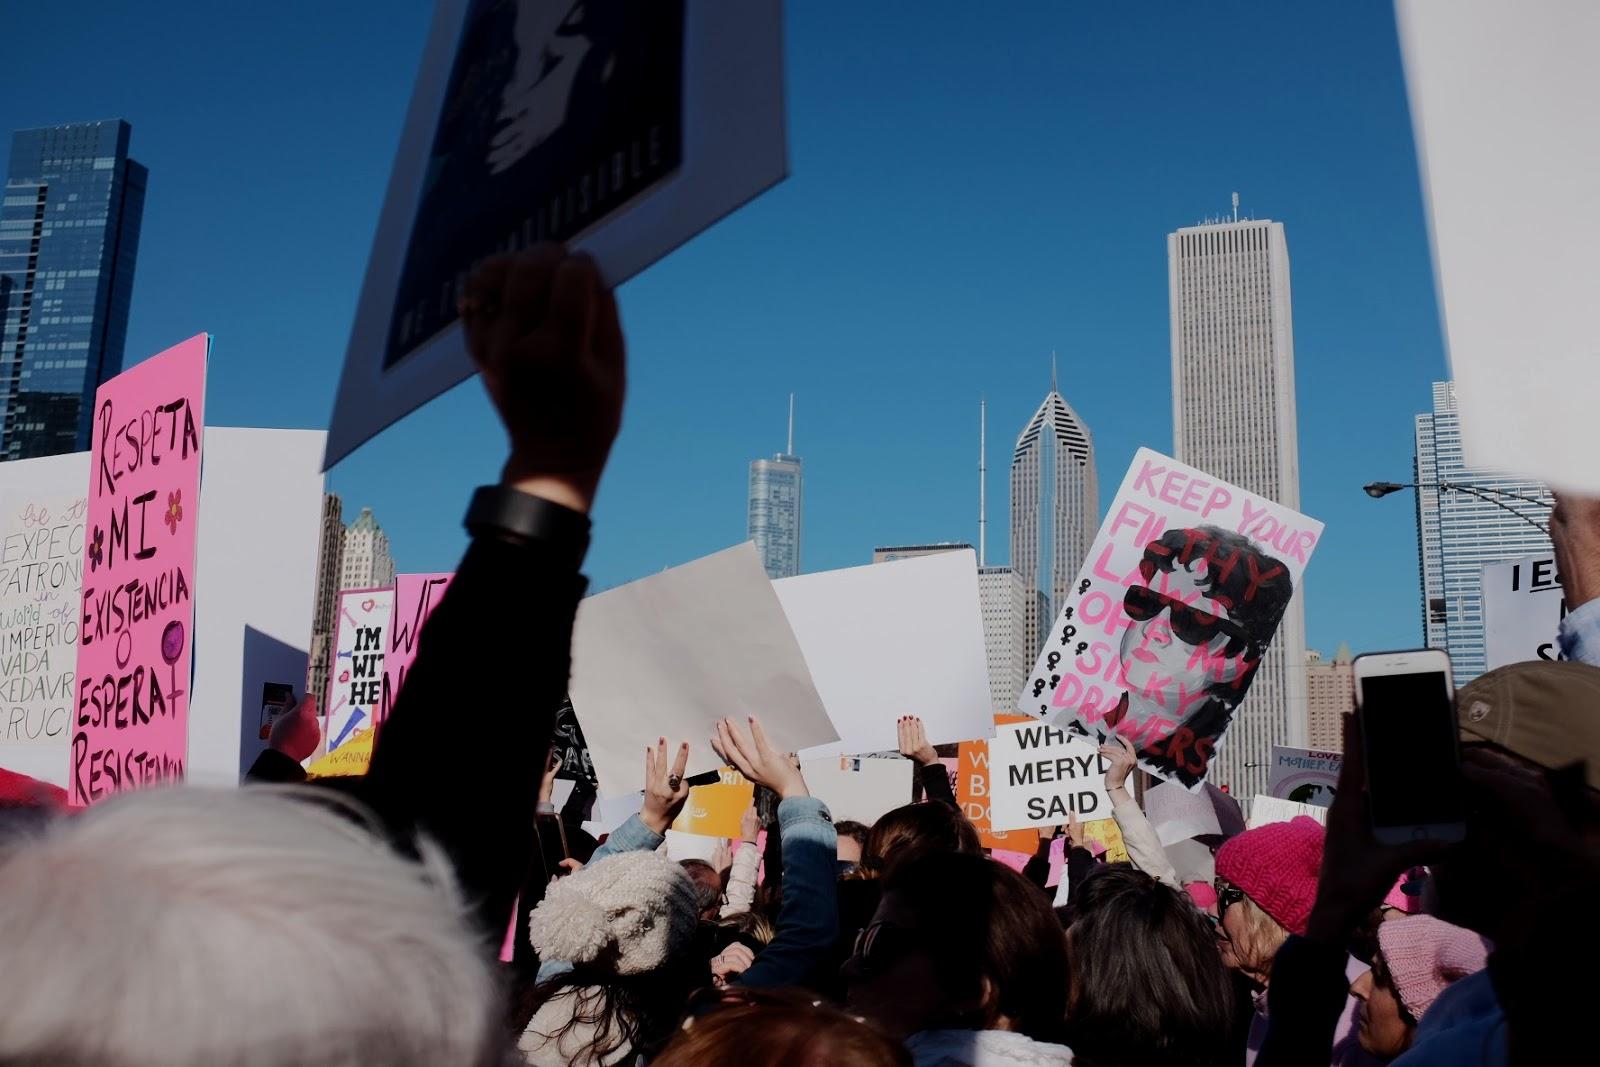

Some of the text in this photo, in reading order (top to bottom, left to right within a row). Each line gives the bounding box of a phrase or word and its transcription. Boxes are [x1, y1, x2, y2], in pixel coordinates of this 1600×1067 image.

[98, 397, 199, 497] RESPETA
[108, 489, 158, 571] MI
[1132, 459, 1317, 565] KEEP YOUR
[82, 566, 189, 646] EXISTENCIA
[1512, 559, 1563, 592] I E
[2, 621, 79, 655] IMPERIO
[77, 665, 167, 730] ESPERA
[1074, 640, 1208, 717] SILKY
[1051, 671, 1215, 775] DRAWERS
[1008, 753, 1109, 786] MERYL
[1027, 790, 1098, 821] SAID
